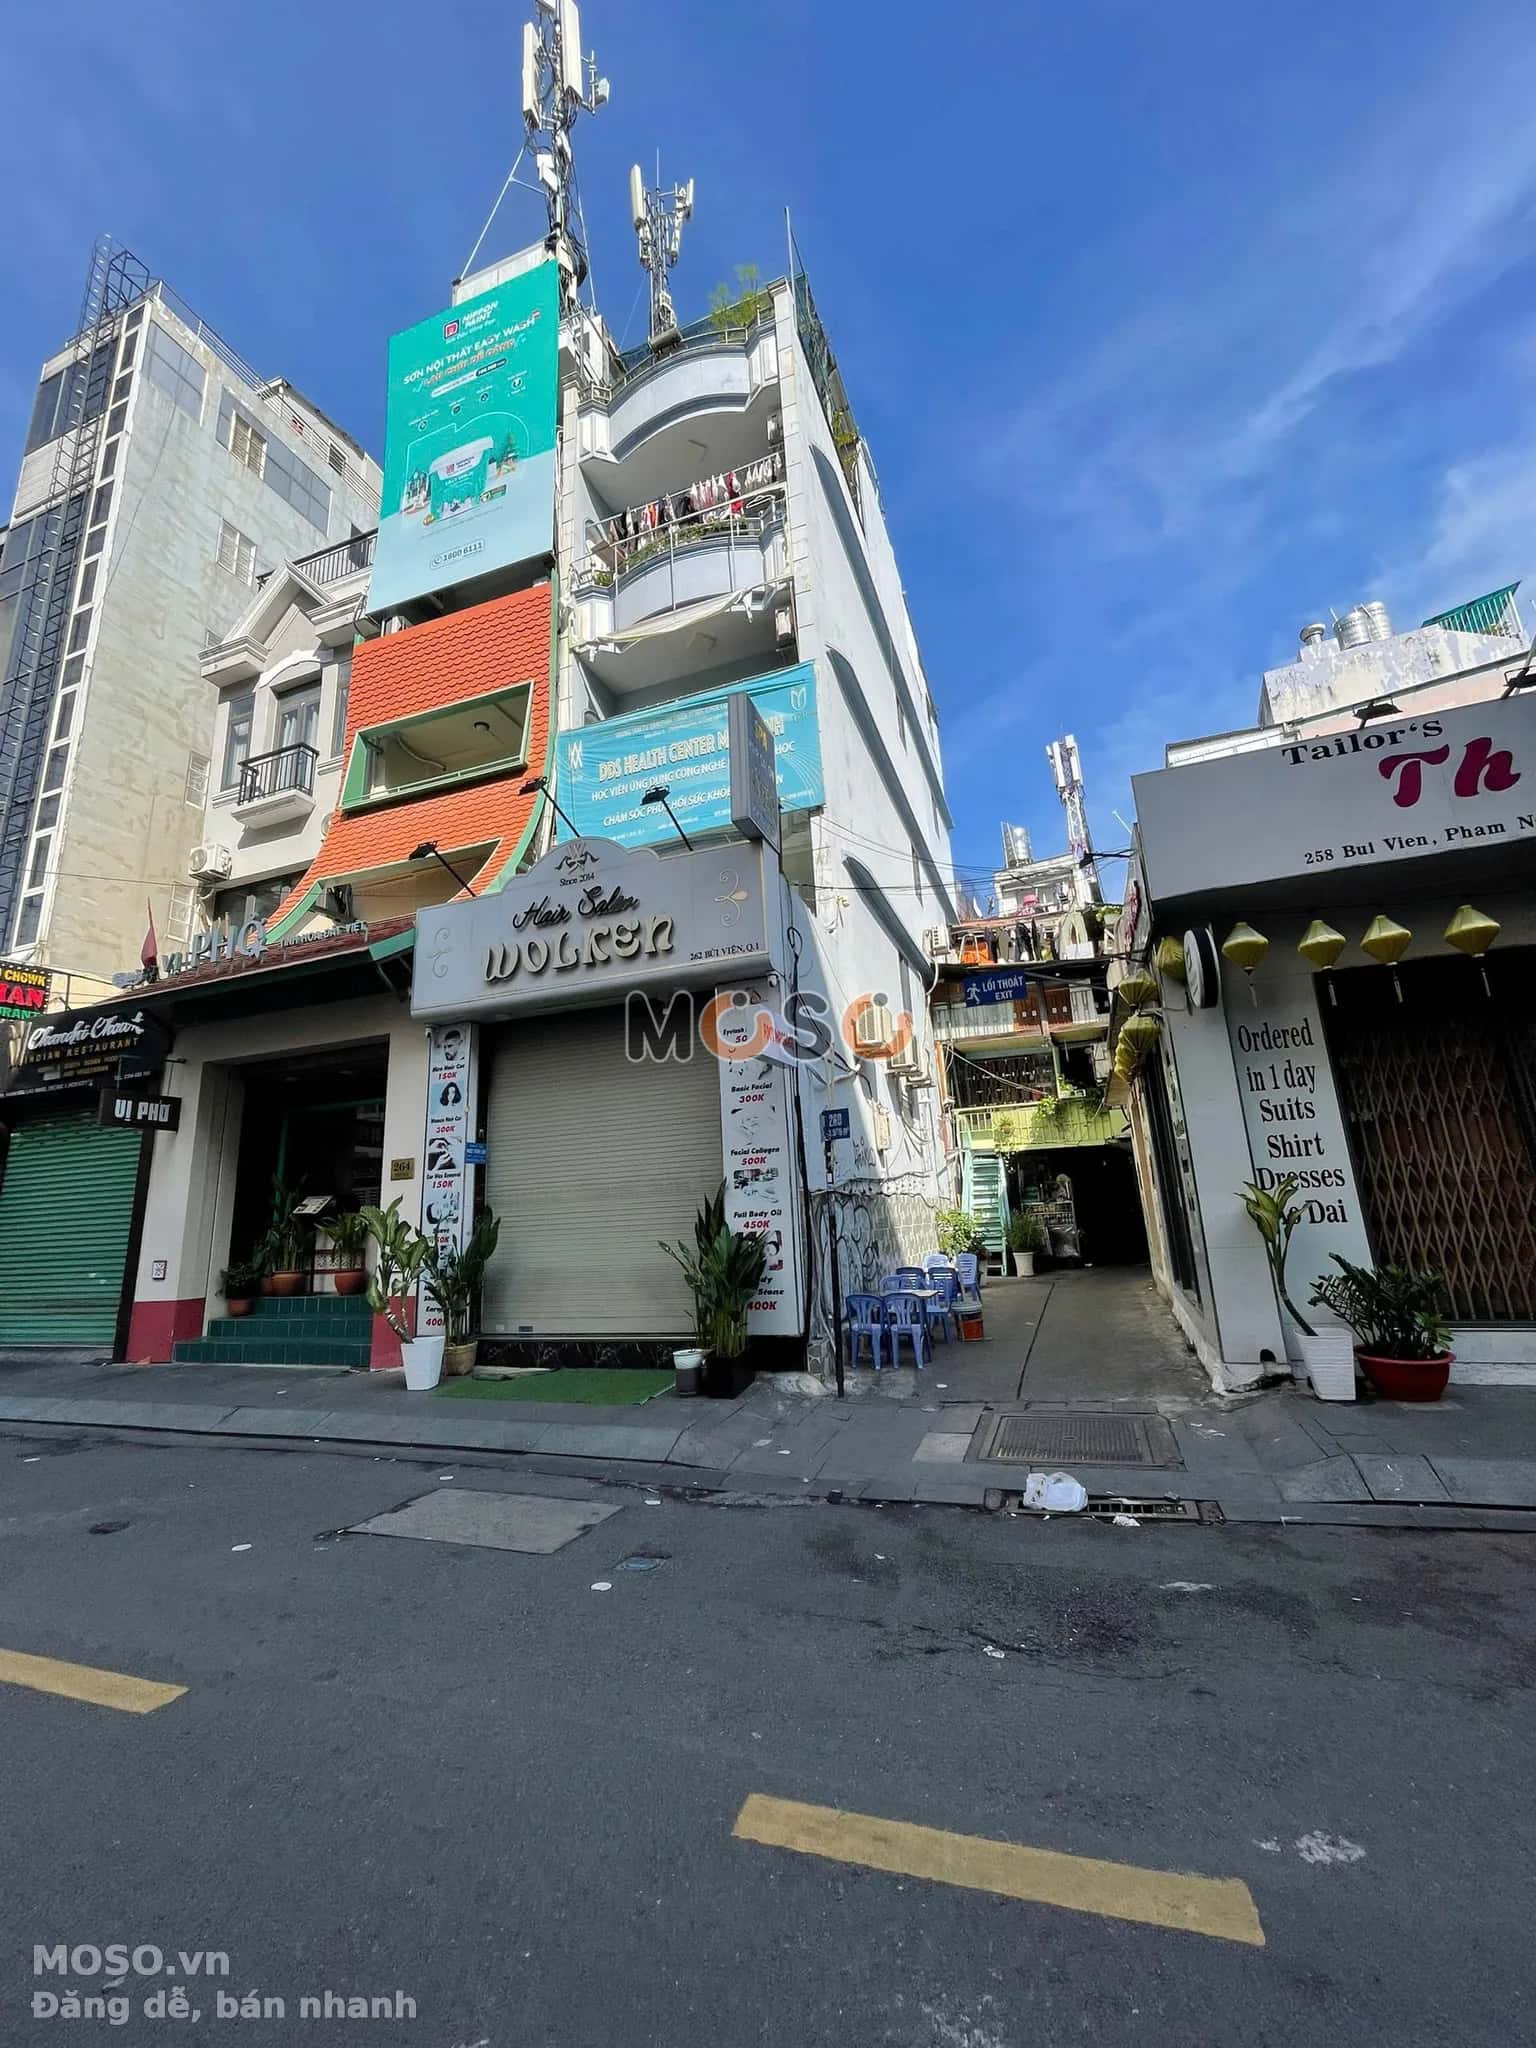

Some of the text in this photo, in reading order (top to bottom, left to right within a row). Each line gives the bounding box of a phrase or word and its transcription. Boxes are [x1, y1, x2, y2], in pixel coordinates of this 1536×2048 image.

[474, 332, 501, 351] EASY
[502, 318, 536, 337] WASH
[623, 745, 667, 776] HEALTH
[669, 734, 716, 763] CENTER
[1304, 848, 1335, 865] 258
[1342, 841, 1376, 859] Bui
[1382, 834, 1438, 852] Vien,
[1444, 822, 1507, 842] Pham
[559, 877, 578, 888] Since
[512, 885, 641, 930] Hair Salon
[4, 969, 46, 987] CHOWK
[994, 990, 1013, 1001] EXIT
[1238, 1017, 1314, 1053] Ordered
[24, 1050, 62, 1065] INDIAN
[66, 1037, 140, 1057] RESTAURANT
[439, 1071, 458, 1080] 150K
[1246, 1059, 1316, 1094] in 1 day
[731, 1082, 773, 1093] Basic Facial
[739, 1093, 765, 1103] 300K
[1259, 1098, 1316, 1123] Suits
[730, 1148, 750, 1156] Facial
[1266, 1130, 1325, 1159] Shirt
[741, 1156, 767, 1166] 500K
[432, 1180, 454, 1189] 150K
[1256, 1166, 1346, 1191] Dresses
[749, 1209, 769, 1218] Body
[770, 1208, 782, 1216] Oil
[1308, 1198, 1349, 1225] Dai
[743, 1219, 770, 1229] 450K
